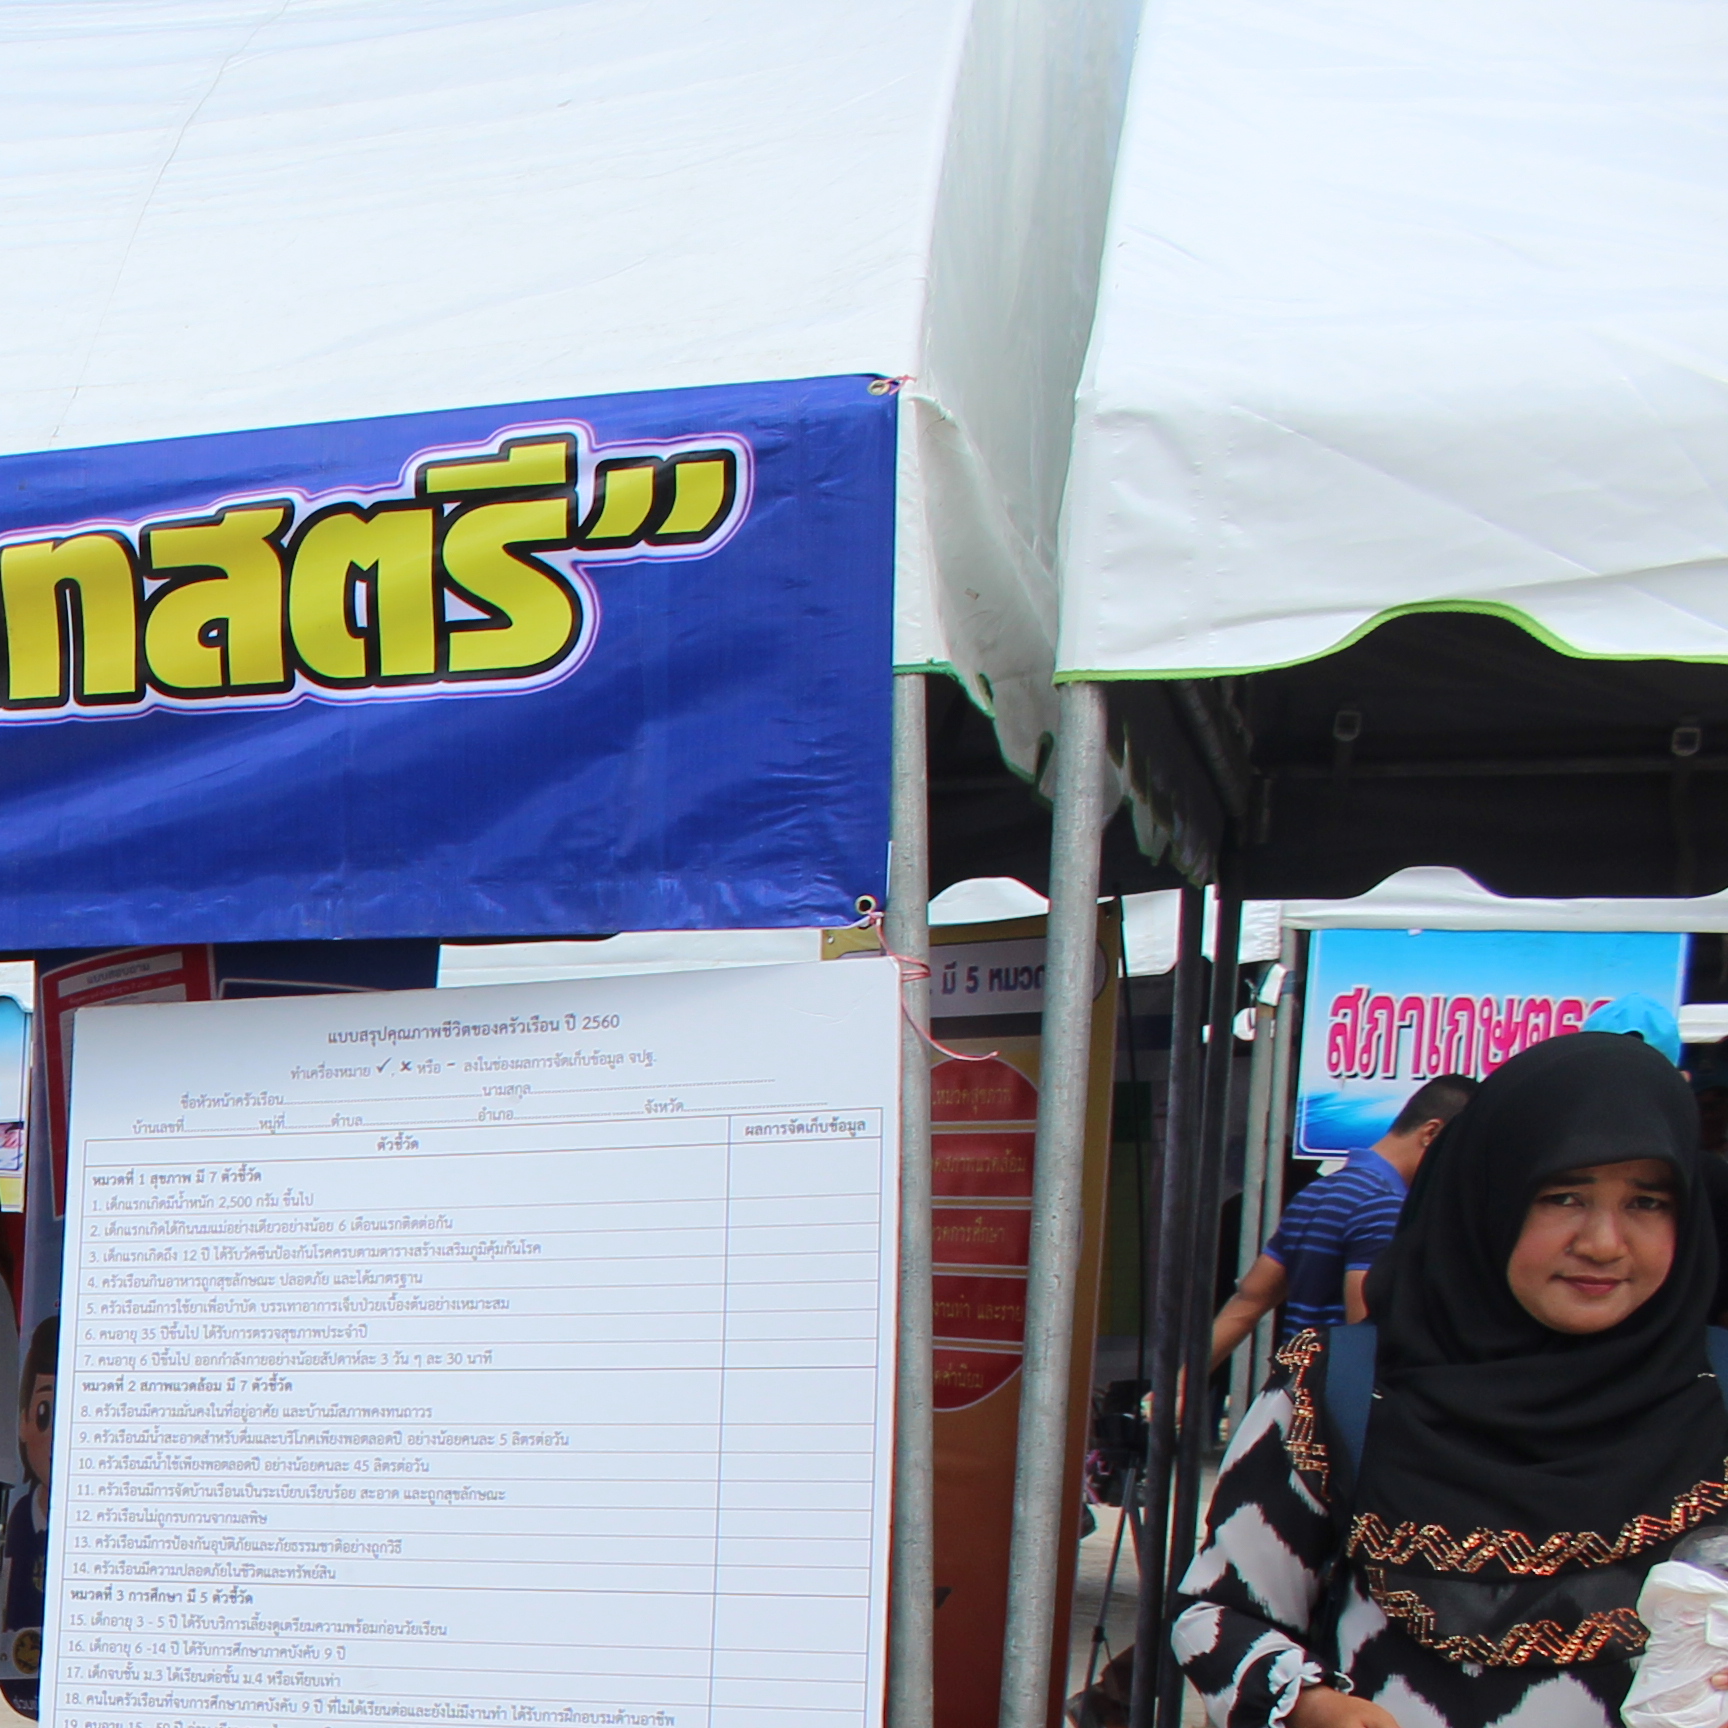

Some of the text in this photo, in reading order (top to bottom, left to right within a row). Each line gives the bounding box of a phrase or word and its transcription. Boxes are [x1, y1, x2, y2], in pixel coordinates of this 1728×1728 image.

[328, 1013, 619, 1046] แบบสรุปคุณภาพชีวิตของครัวเรือน ปี 2560
[376, 1116, 866, 1150] ตัวชี้วัด ผลการจัดเก็บข้อมูล
[92, 1163, 261, 1189] หมวดที่ 1 สุขภาพ มี 7 ตัวชี้วัด
[82, 1373, 292, 1391] หมวดที่ 2 สภาพแวดล้อม มี 7 ตัวชี้วัด
[70, 1583, 252, 1604] หมวดที่ 3 การศึกษา มี 5 ตัวชี้วัด
